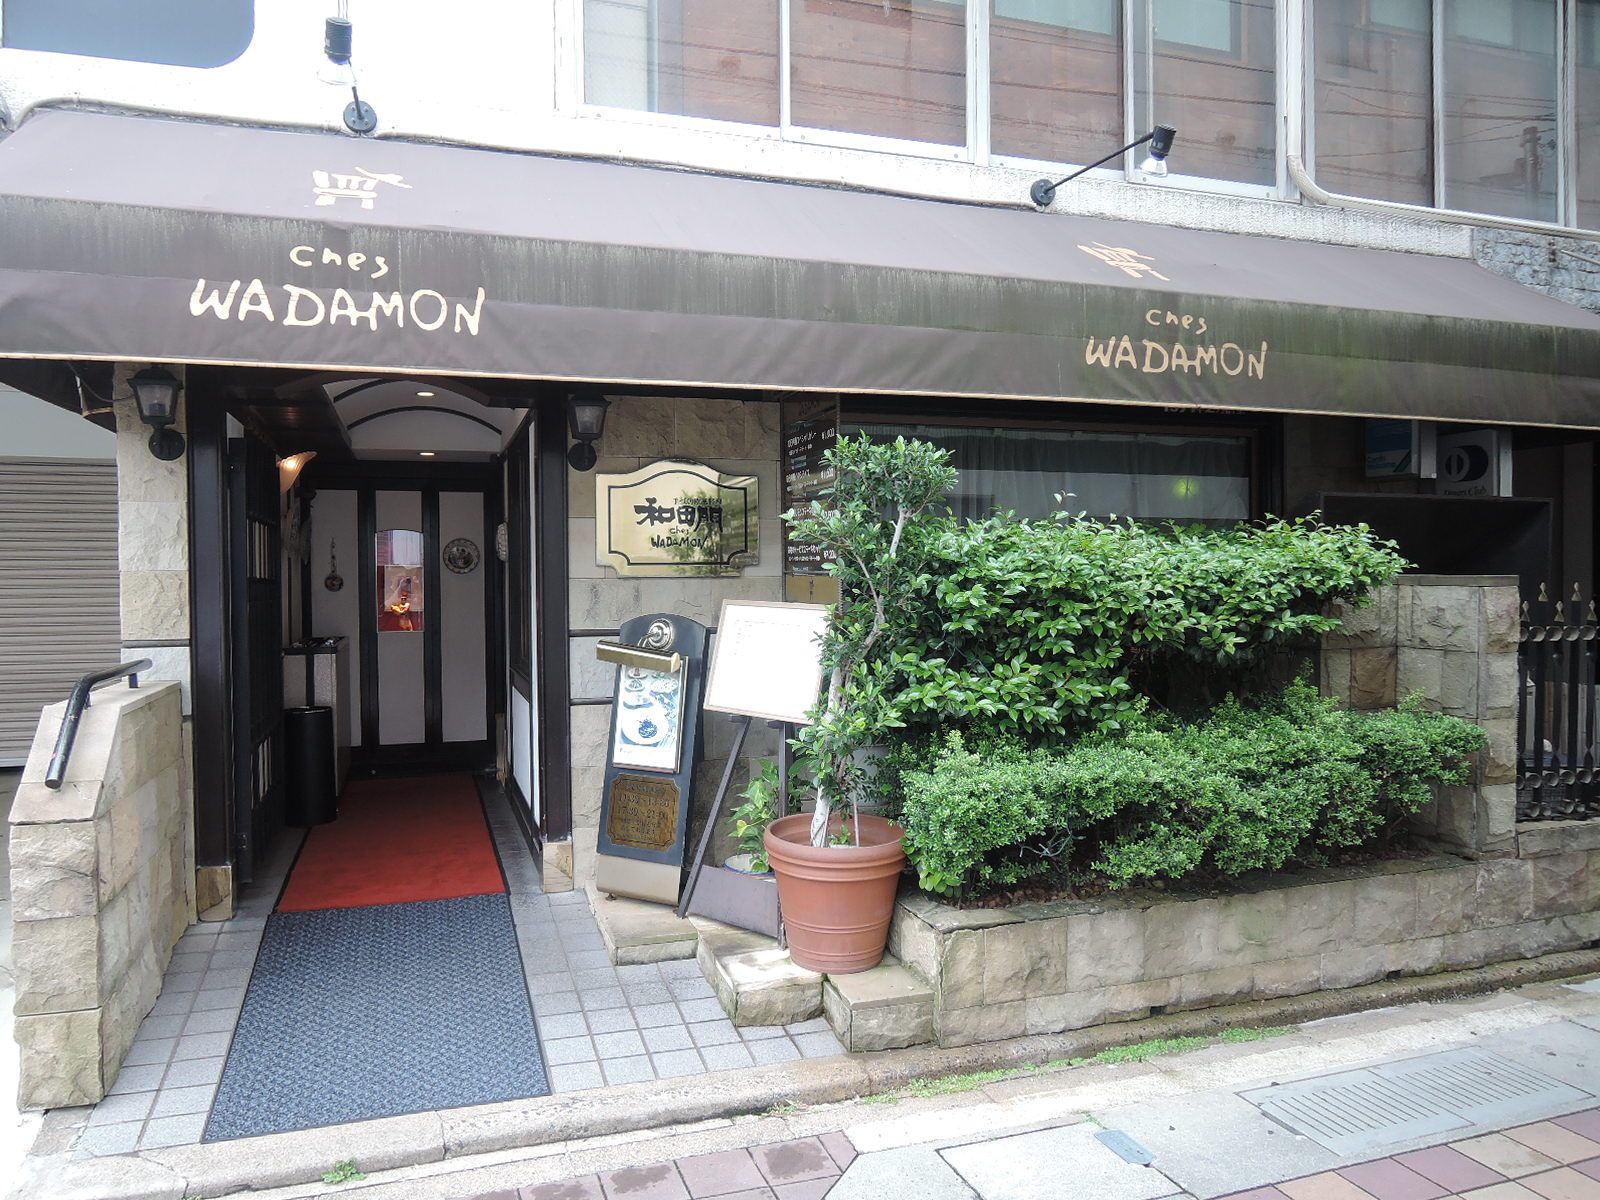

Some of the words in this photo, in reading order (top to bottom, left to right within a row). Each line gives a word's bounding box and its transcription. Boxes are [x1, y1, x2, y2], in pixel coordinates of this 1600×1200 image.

[188, 277, 487, 337] WADAMON
[1084, 334, 1268, 381] WADAMON
[633, 496, 724, 533] 和田門
[650, 534, 708, 550] WADAMON
